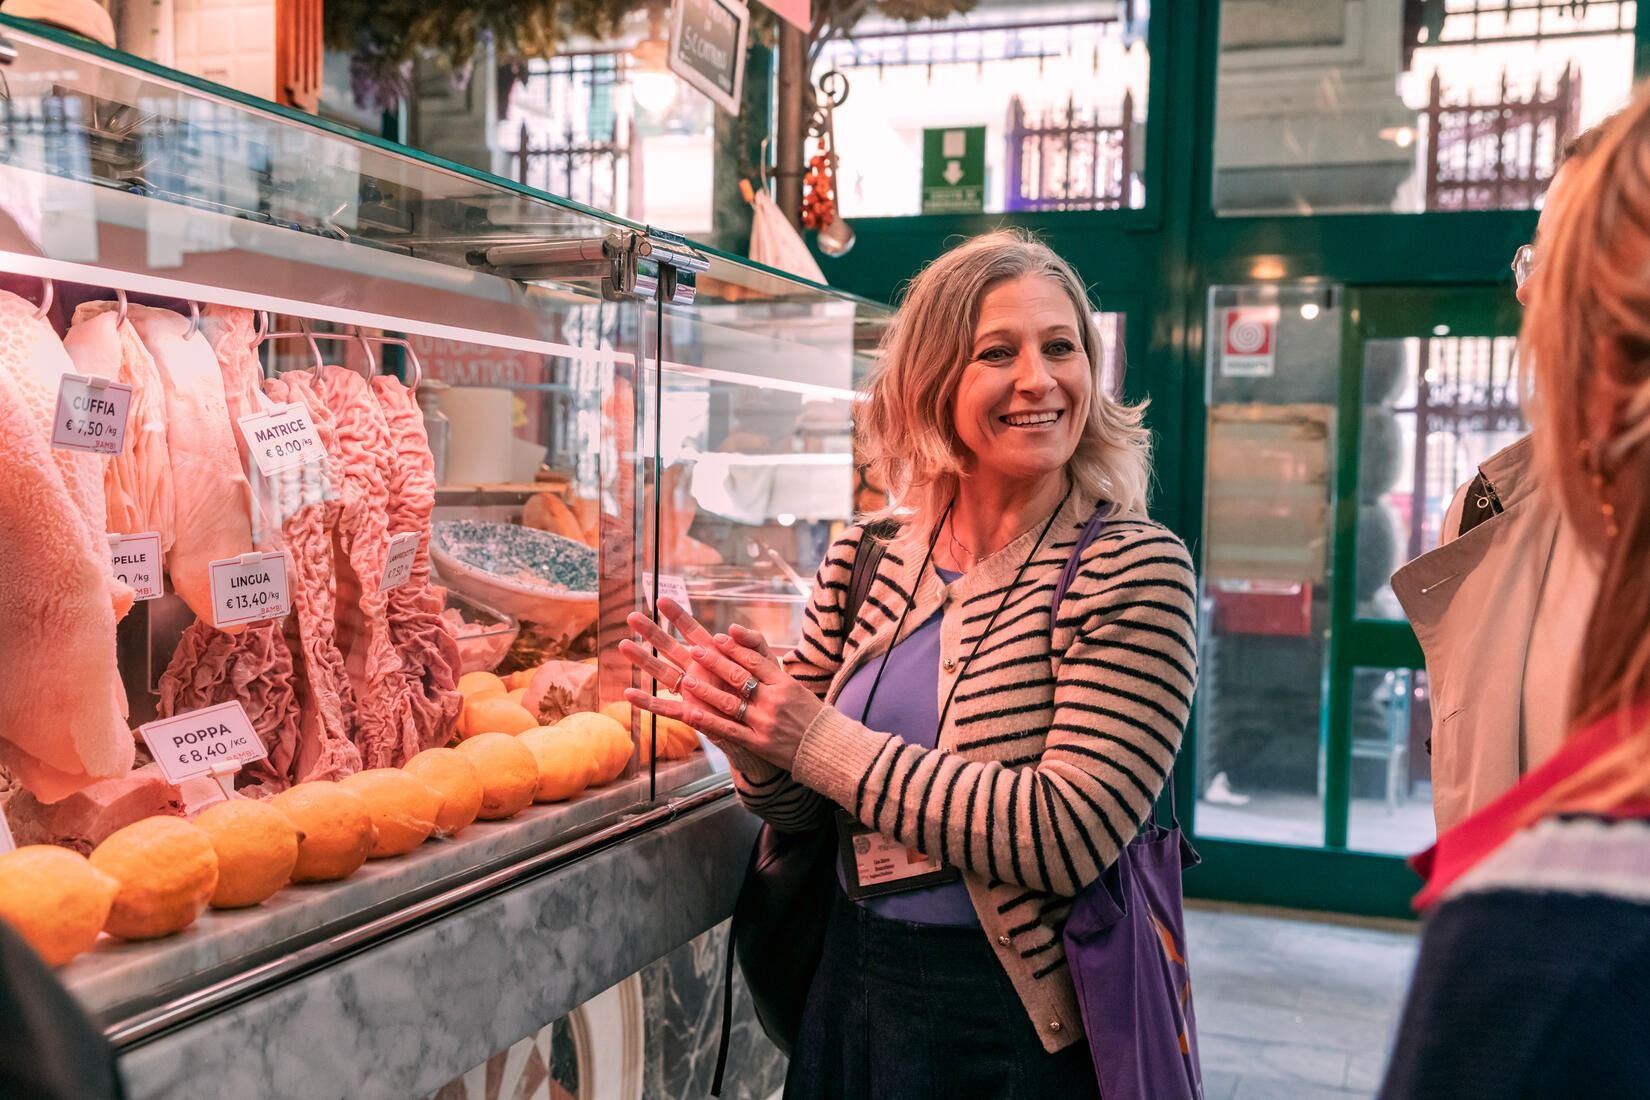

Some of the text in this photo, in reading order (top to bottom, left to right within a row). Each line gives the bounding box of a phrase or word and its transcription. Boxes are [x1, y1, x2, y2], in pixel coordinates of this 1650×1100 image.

[73, 396, 115, 416] CUFFIA
[255, 419, 306, 442] MATRICE
[230, 572, 271, 588] LINGUA
[172, 723, 232, 749] POPPA
